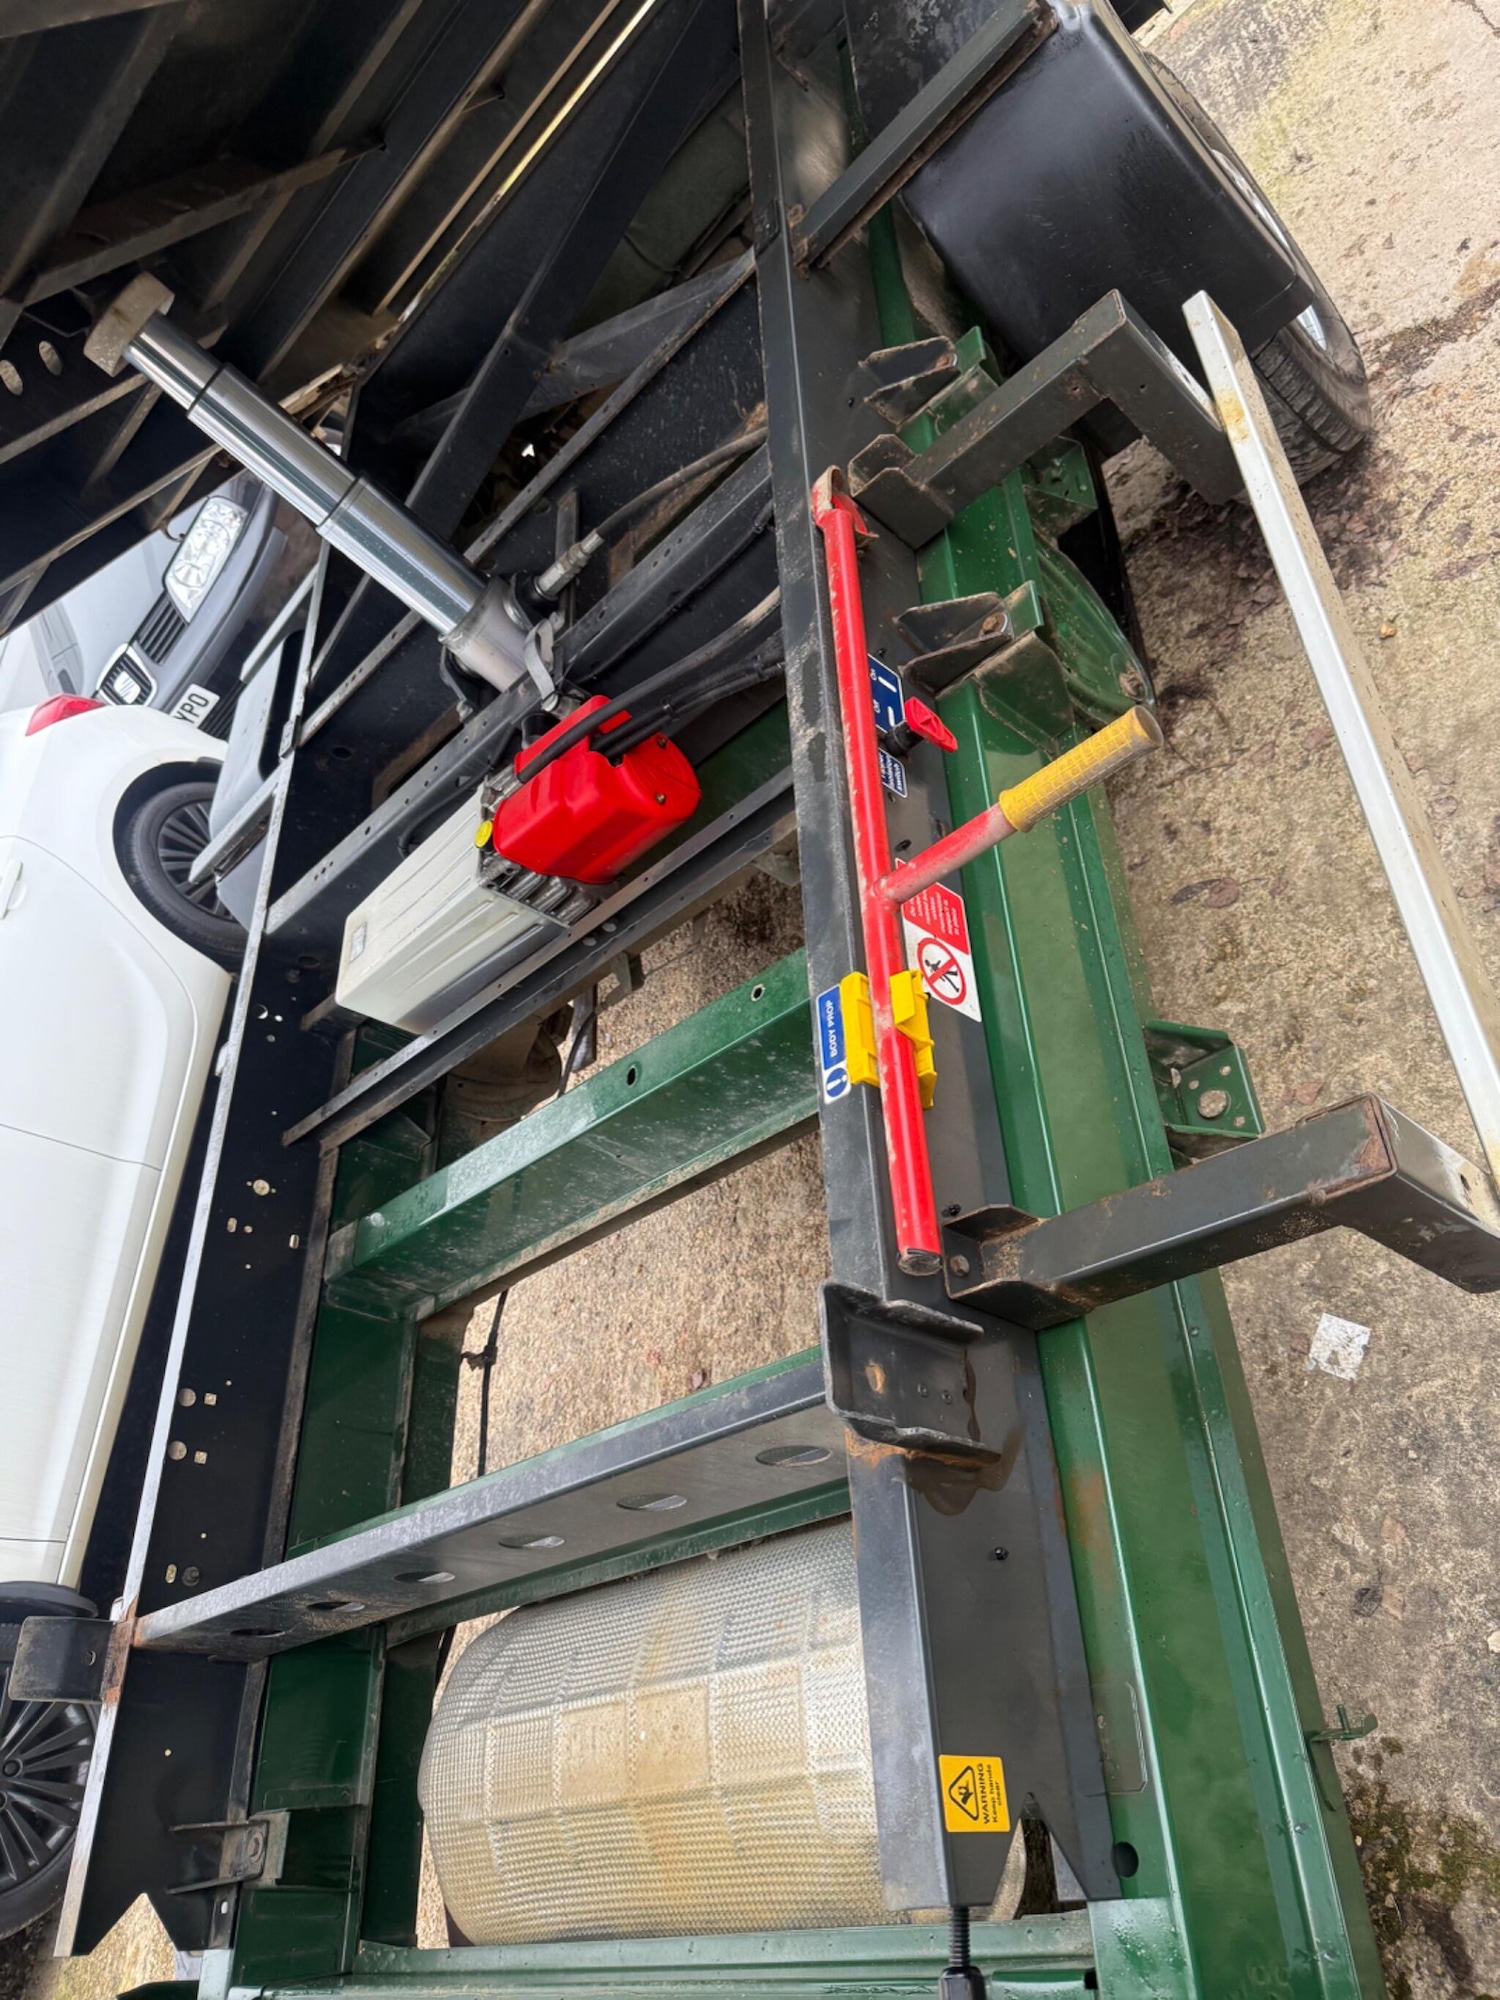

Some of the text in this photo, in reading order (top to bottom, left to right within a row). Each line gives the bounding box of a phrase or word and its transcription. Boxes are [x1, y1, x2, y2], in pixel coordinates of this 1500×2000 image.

[172, 693, 209, 724] YPO
[825, 1000, 838, 1058] BODY PROP
[977, 1763, 990, 1824] WARNING
[986, 1764, 995, 1794] hands
